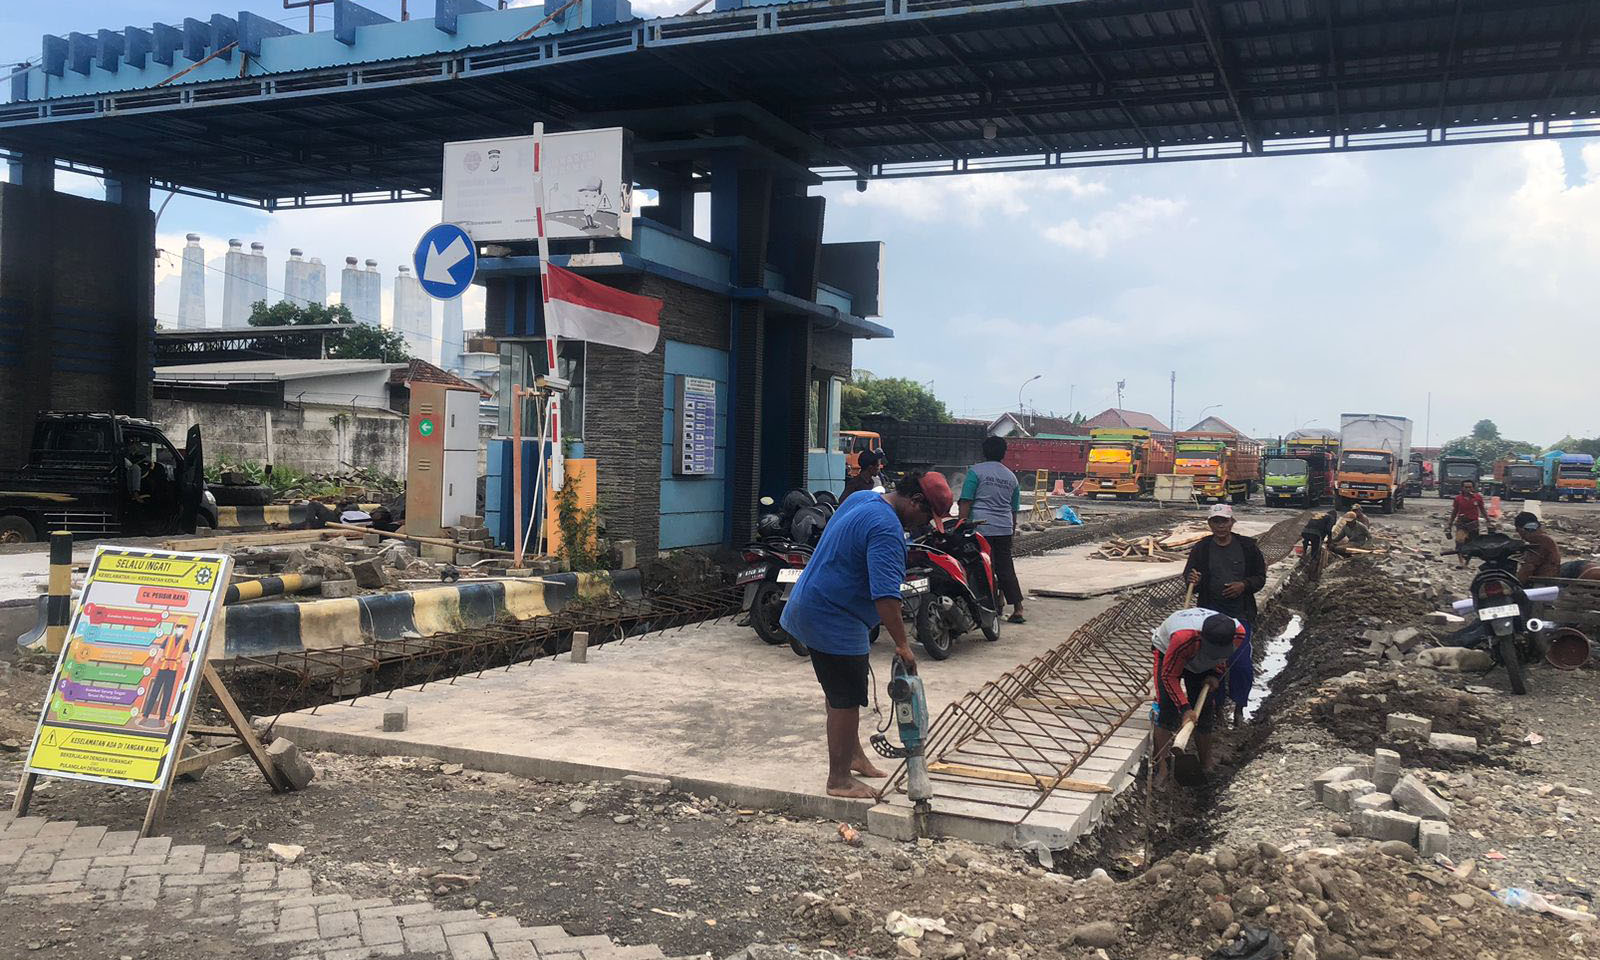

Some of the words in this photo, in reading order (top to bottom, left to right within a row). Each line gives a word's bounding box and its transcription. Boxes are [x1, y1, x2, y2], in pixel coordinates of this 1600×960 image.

[115, 559, 144, 570] SELALU
[71, 737, 105, 746] KESELAMATAN
[123, 743, 144, 751] TANGAN
[144, 745, 160, 753] ANDA
[60, 752, 89, 760] BEKERJALAH
